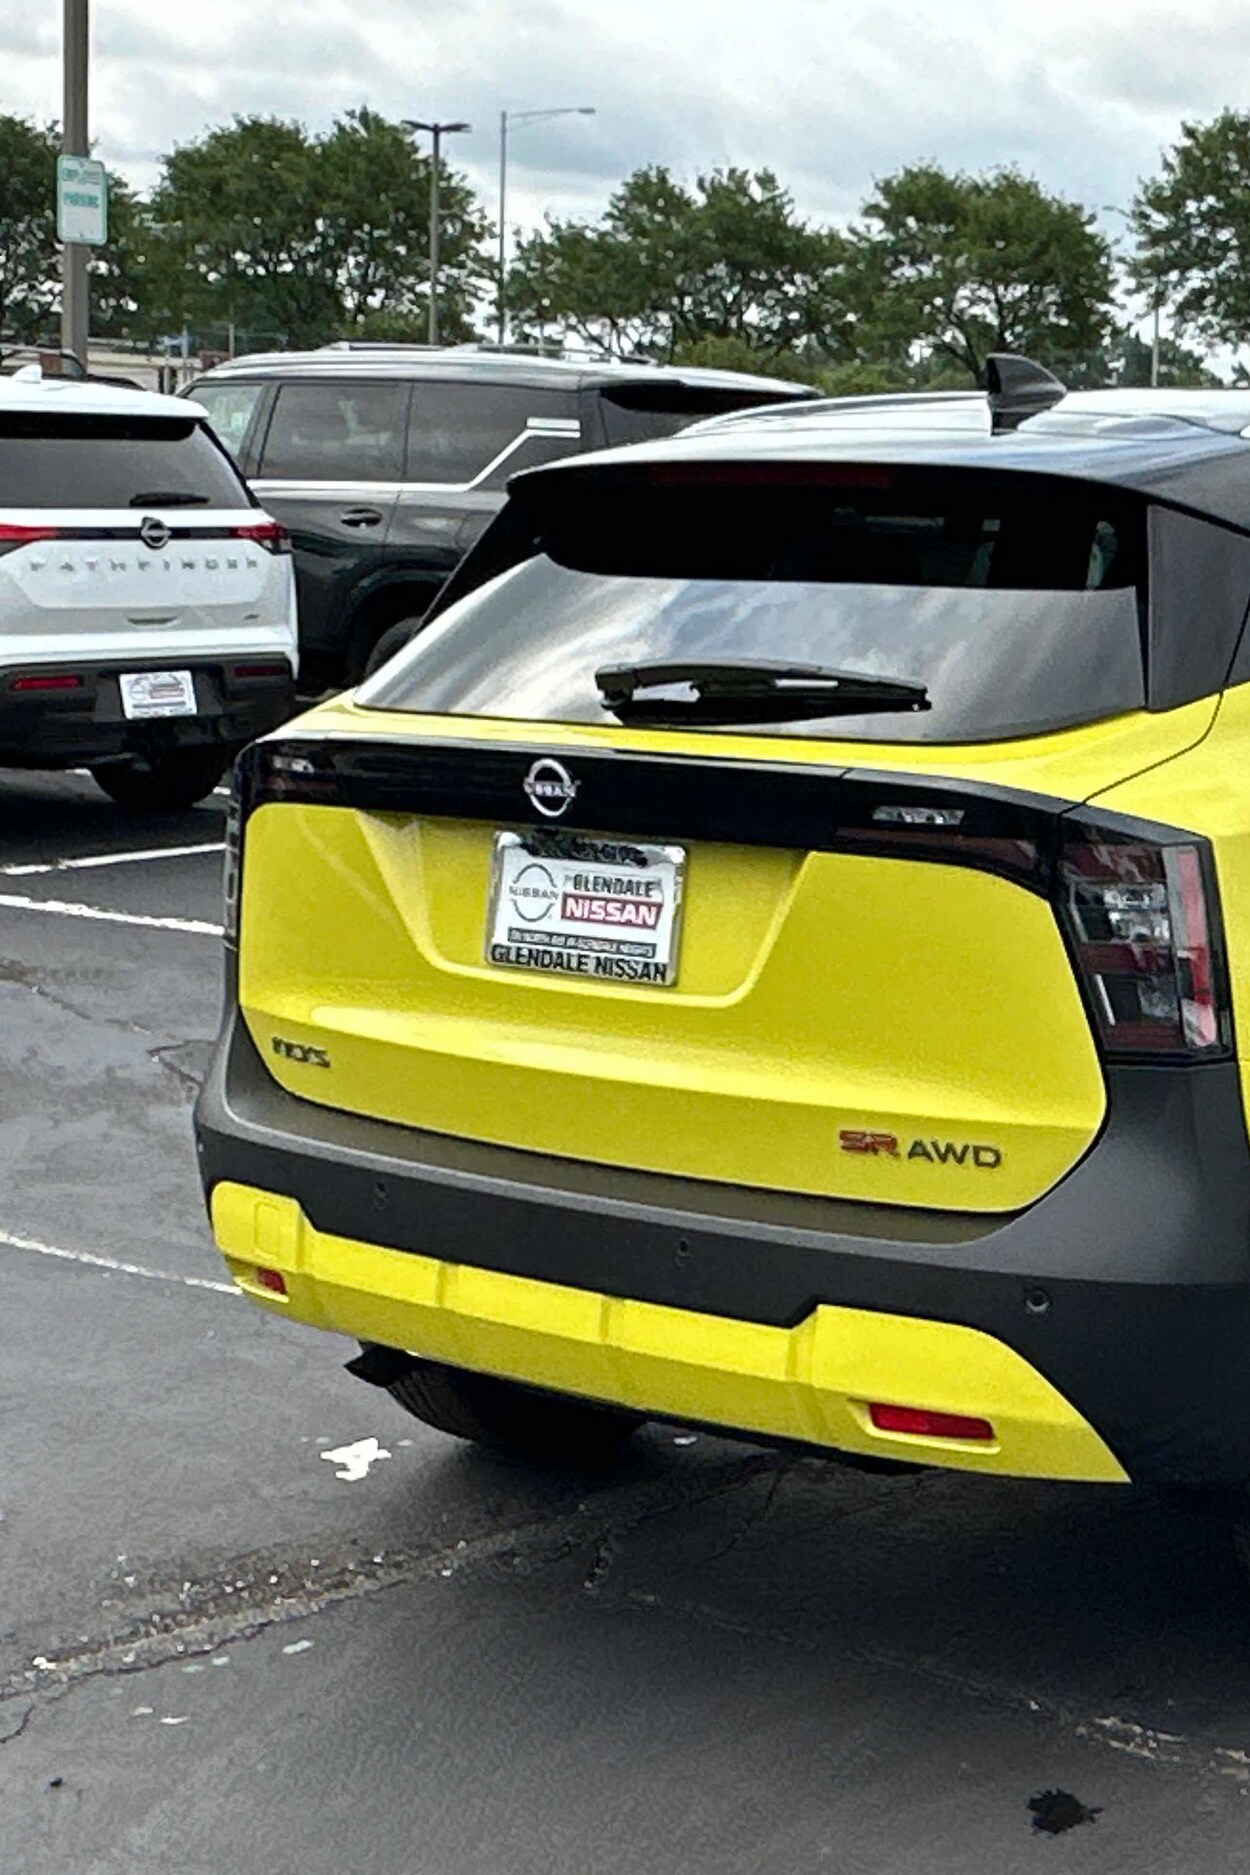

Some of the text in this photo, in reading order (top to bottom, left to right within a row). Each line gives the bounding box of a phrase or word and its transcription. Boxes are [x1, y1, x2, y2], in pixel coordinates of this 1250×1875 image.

[30, 556, 258, 571] PATHFINDER
[573, 873, 655, 897] GLENDALE
[565, 898, 658, 926] NISSAN
[491, 943, 667, 983] GLENDALE NISSAN
[839, 1130, 1001, 1168] SR AWD
